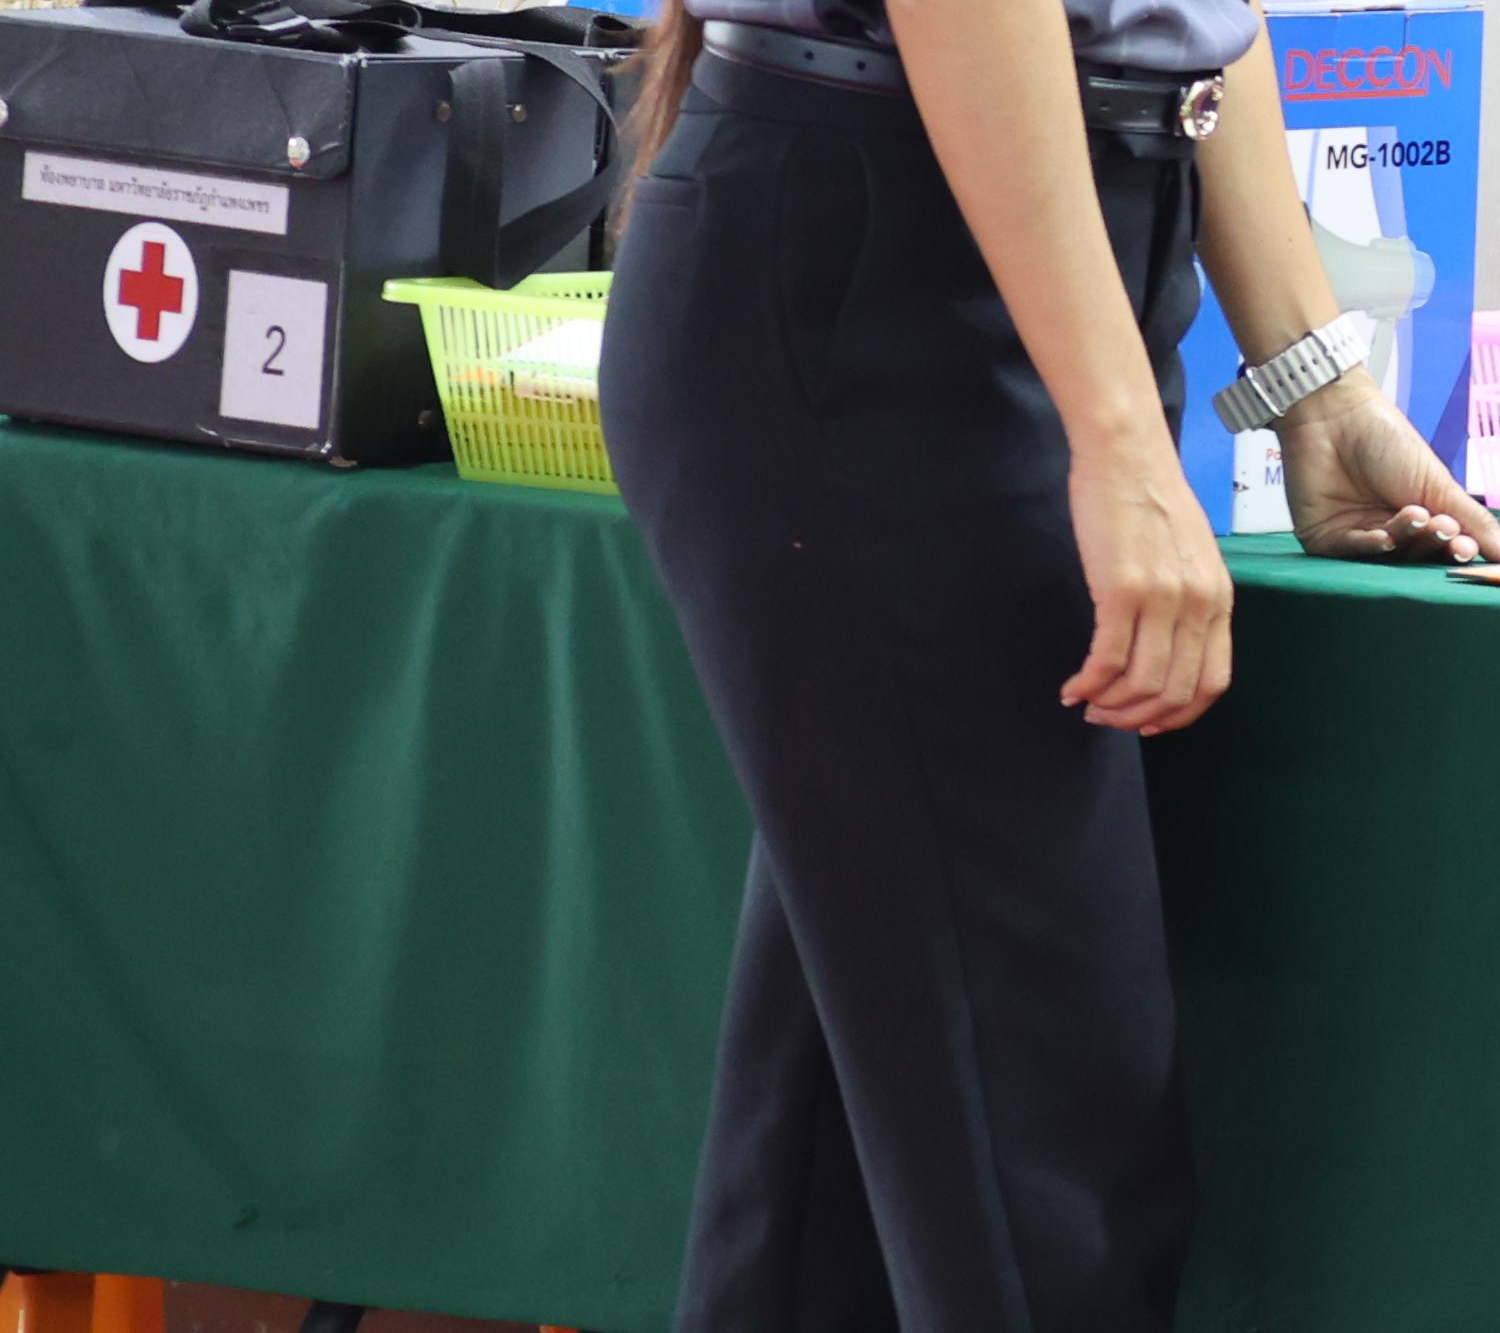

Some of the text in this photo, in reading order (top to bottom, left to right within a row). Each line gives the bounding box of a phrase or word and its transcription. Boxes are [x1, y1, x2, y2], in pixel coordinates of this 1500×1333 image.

[1285, 45, 1453, 96] DECCON
[1326, 139, 1452, 170] MG-1002B
[261, 324, 287, 376] 2
